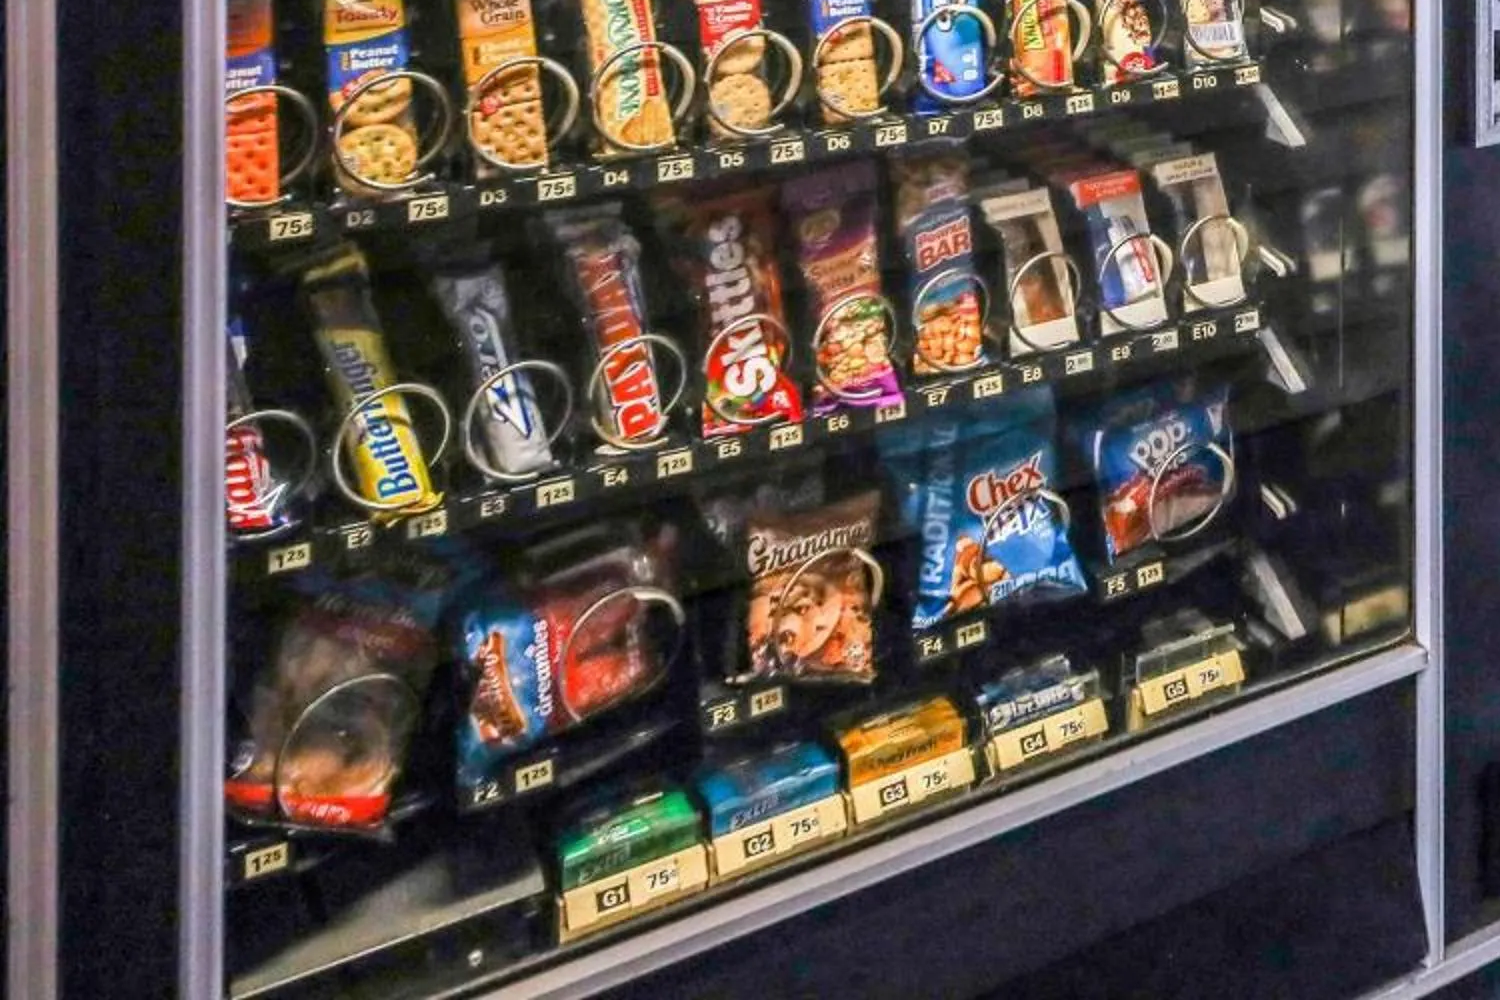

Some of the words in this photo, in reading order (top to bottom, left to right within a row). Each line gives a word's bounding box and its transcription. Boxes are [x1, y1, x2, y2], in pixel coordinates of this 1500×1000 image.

[480, 9, 526, 25] Grain
[350, 43, 400, 59] Peanut
[350, 56, 395, 69] Butter
[226, 64, 262, 78] anut
[1193, 75, 1217, 88] D10
[1111, 90, 1131, 103] D9
[1023, 106, 1043, 119] D8
[929, 119, 948, 134] D7
[827, 135, 849, 150] D6
[720, 153, 744, 168] D5
[604, 169, 629, 186] D4
[480, 189, 506, 206] D3
[919, 234, 971, 270] BAR
[704, 213, 778, 396] Skttles
[1193, 324, 1217, 339] E10
[1023, 368, 1043, 382] E8
[928, 392, 948, 407] E7
[827, 418, 850, 431] E6
[718, 443, 741, 457] E5
[966, 451, 1044, 512] Chex
[1106, 579, 1126, 593] F5
[922, 639, 943, 655] F4
[1023, 737, 1043, 751] G4
[474, 785, 498, 801] F2
[746, 836, 772, 854] G2
[602, 888, 626, 906] G1
